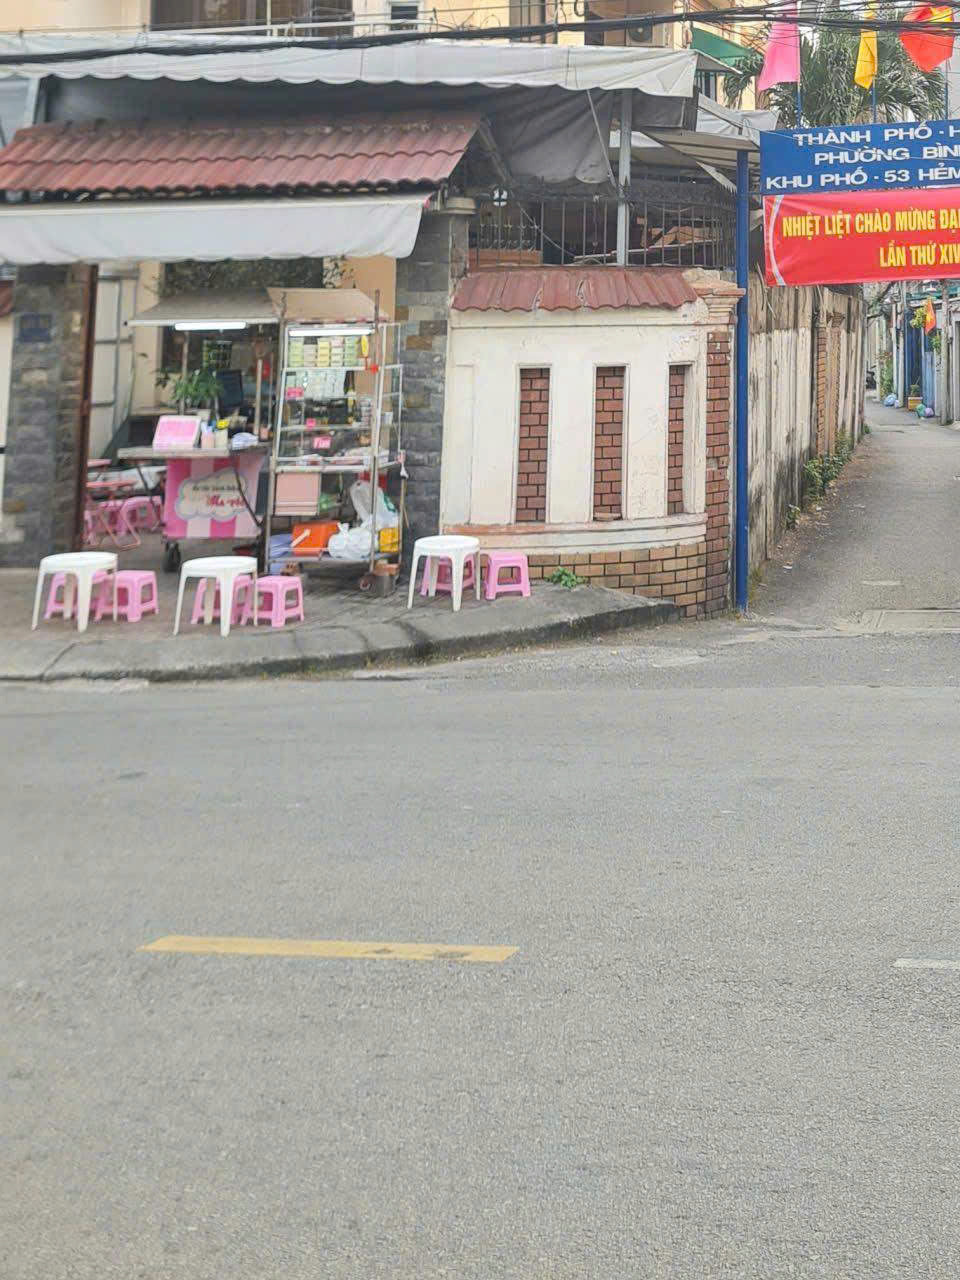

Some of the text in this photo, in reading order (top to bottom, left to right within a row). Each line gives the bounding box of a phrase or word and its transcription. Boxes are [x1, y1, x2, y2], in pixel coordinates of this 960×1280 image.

[793, 128, 870, 146] THÀNH
[884, 122, 932, 141] PHỐ
[814, 146, 910, 165] PHƯỜNG
[766, 175, 812, 189] KHU
[820, 167, 868, 187] PHỐ
[884, 170, 909, 183] 53
[783, 212, 821, 240] NHIỆT
[825, 210, 851, 239] LIỆT
[855, 208, 891, 234] CHÀO
[895, 205, 936, 232] MỪNG
[880, 240, 906, 267] LẦN
[910, 240, 936, 265] THỨ
[939, 243, 960, 264] XIV
